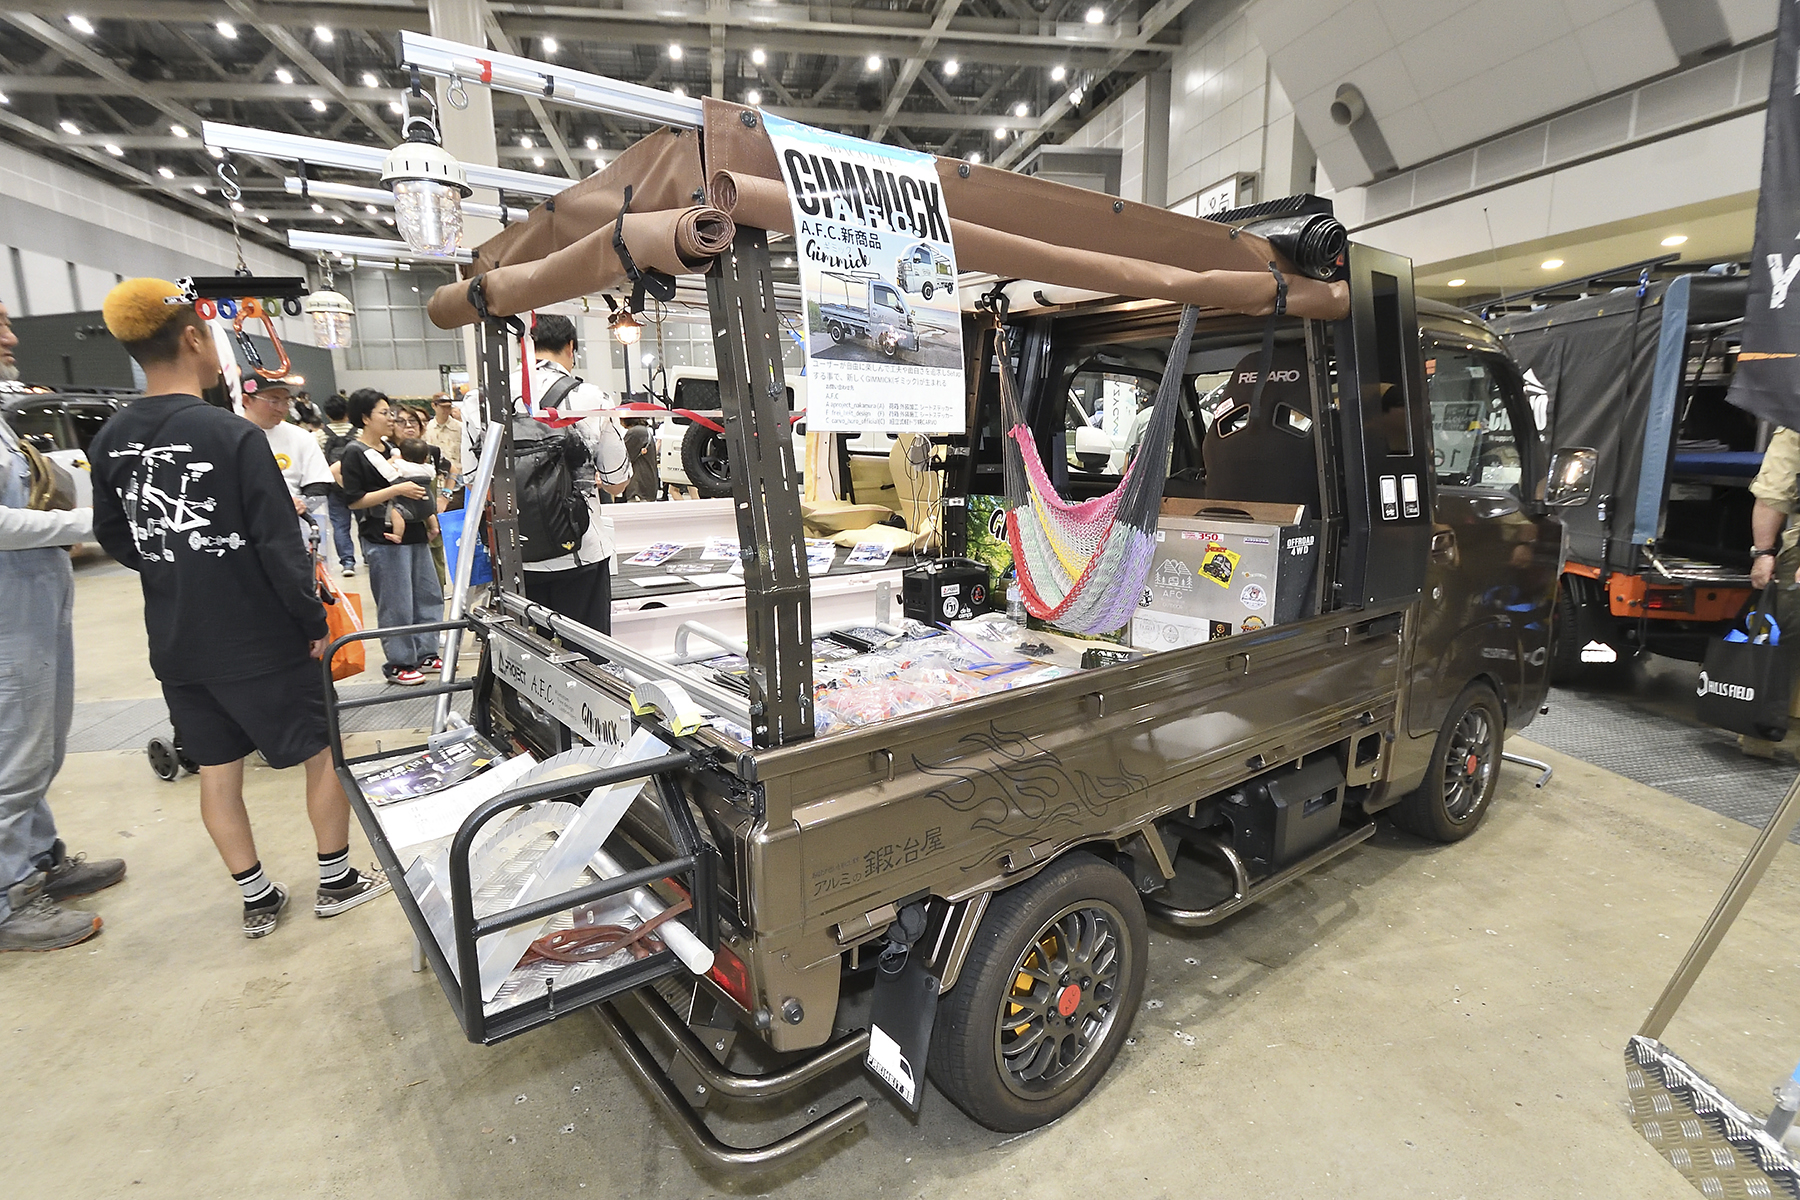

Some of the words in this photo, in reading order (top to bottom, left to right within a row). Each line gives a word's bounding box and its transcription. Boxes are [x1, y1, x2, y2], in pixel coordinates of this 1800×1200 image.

[784, 149, 951, 243] GIMMICK
[801, 220, 882, 250] A.F.C.新商品
[805, 238, 872, 270] Gimmick
[1238, 369, 1301, 384] REARO
[1197, 532, 1219, 542] 350
[1290, 546, 1310, 557] 4WD
[1162, 590, 1183, 600] AFC
